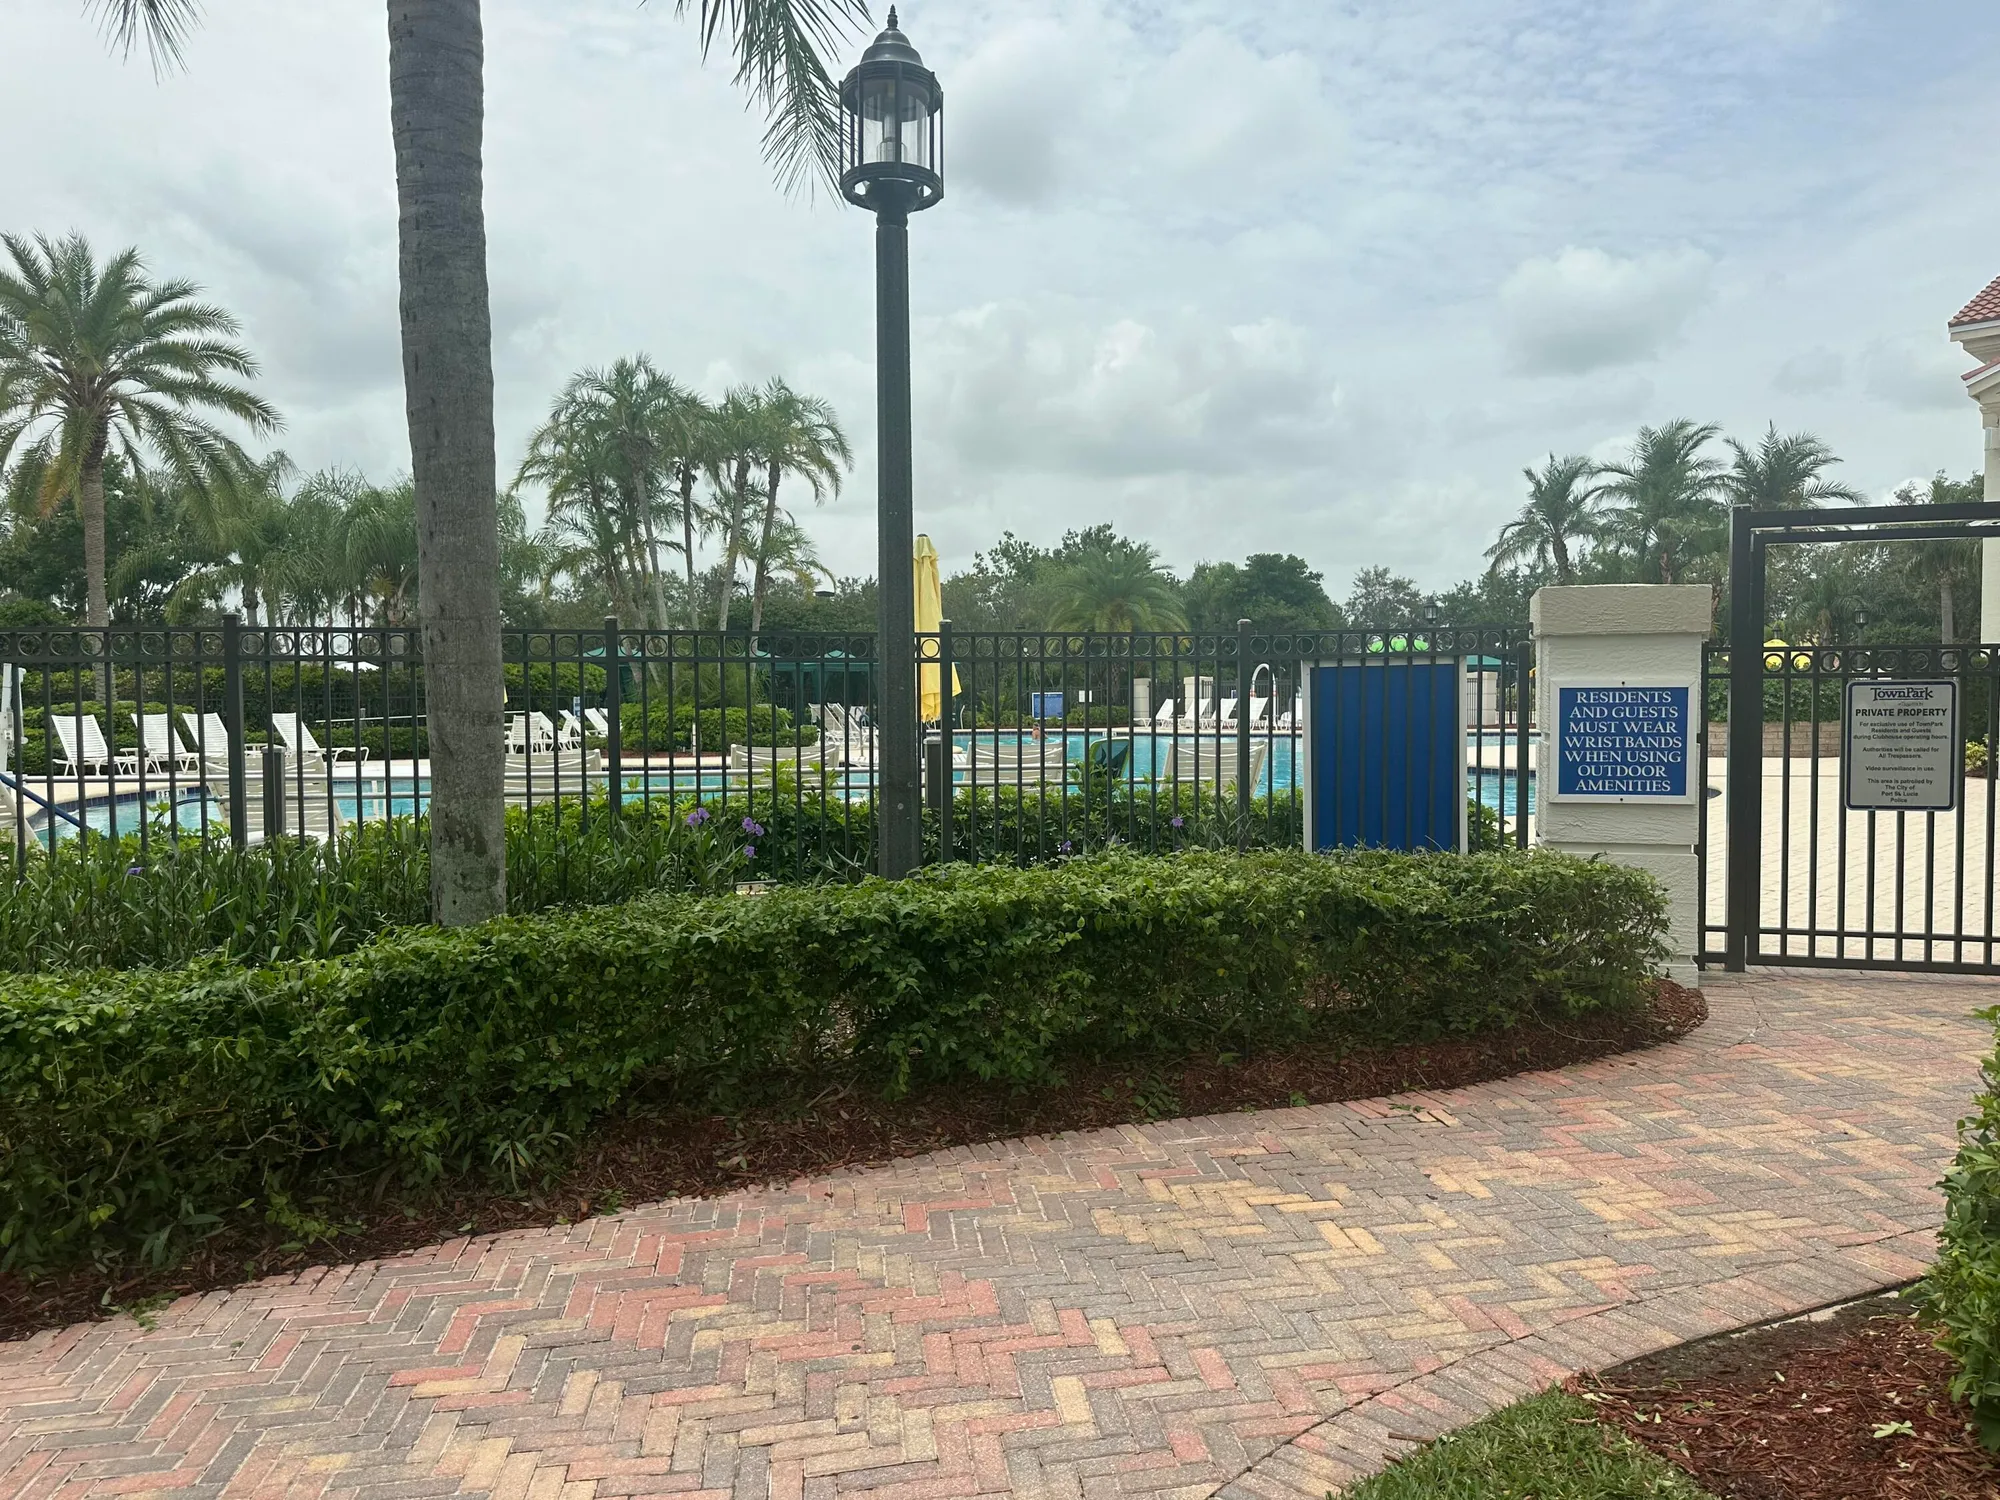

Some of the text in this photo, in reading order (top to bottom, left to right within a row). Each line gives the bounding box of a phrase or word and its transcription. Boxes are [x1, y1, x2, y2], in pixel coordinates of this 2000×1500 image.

[1577, 691, 1671, 703] RESIDENTS
[1870, 687, 1934, 701] TownPark
[1569, 706, 1678, 718] AND GUESTS
[1569, 722, 1677, 732] MUST WEAR
[1565, 736, 1682, 748] WRISTBANDS
[1565, 751, 1681, 762] WHEN USING
[1578, 765, 1667, 777] OUTDOOR
[1576, 780, 1670, 791] AMENITIES
